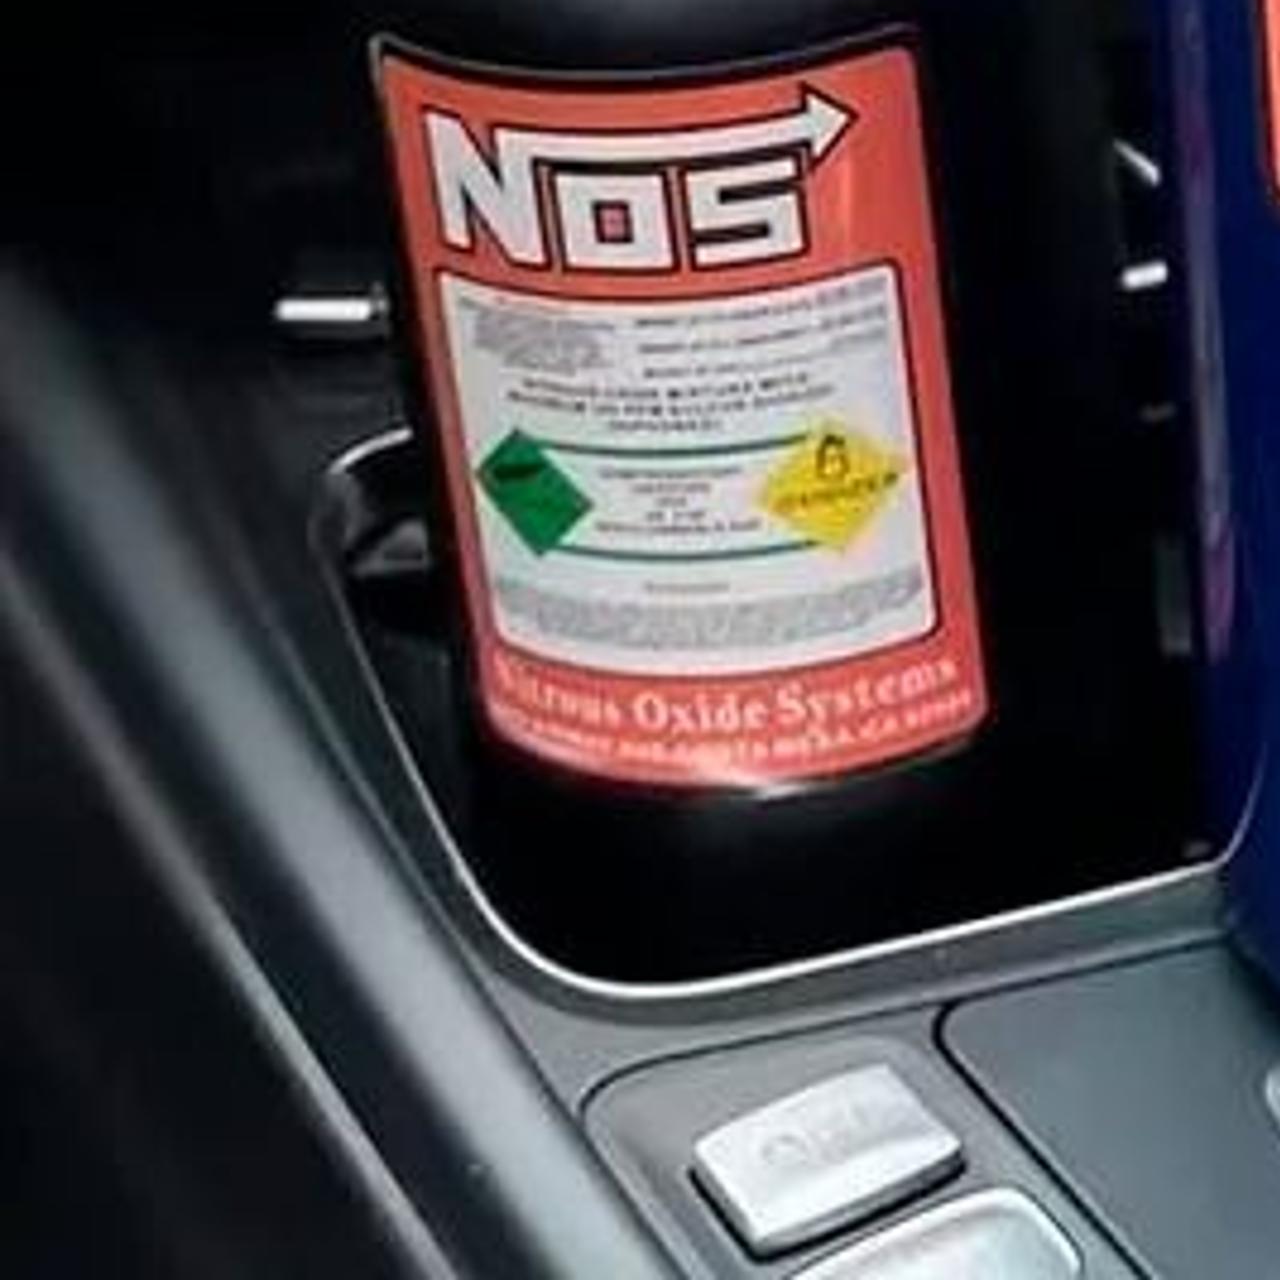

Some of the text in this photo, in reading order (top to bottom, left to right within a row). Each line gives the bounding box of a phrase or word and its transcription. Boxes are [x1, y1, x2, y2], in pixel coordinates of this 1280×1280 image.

[422, 81, 858, 275] NOS
[632, 690, 769, 735] Oxide
[775, 655, 958, 721] Systems
